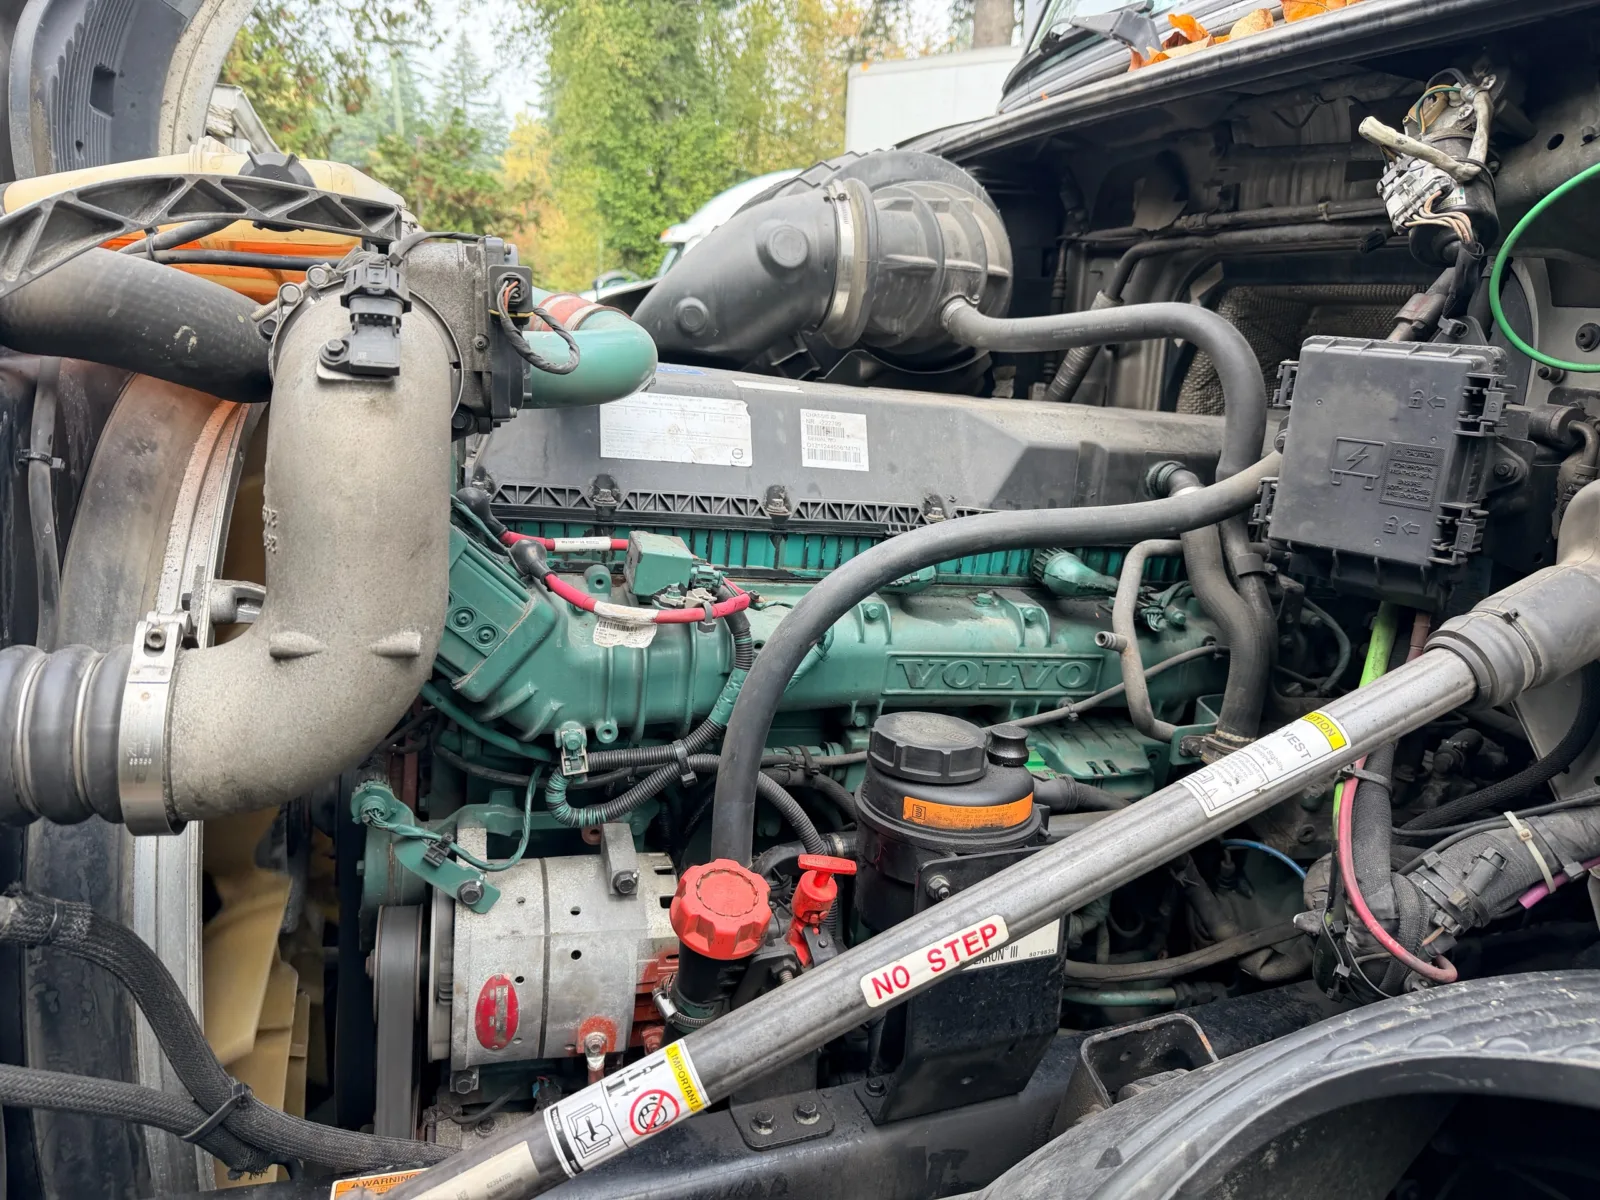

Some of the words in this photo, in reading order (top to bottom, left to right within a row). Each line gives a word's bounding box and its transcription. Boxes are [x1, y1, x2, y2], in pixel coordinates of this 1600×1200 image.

[896, 659, 1093, 690] VOLVO
[1304, 714, 1336, 737] UTION
[1282, 730, 1312, 760] VEST
[871, 965, 911, 1000] NO
[926, 923, 997, 973] STEP
[671, 1054, 699, 1106] IMPORTANT
